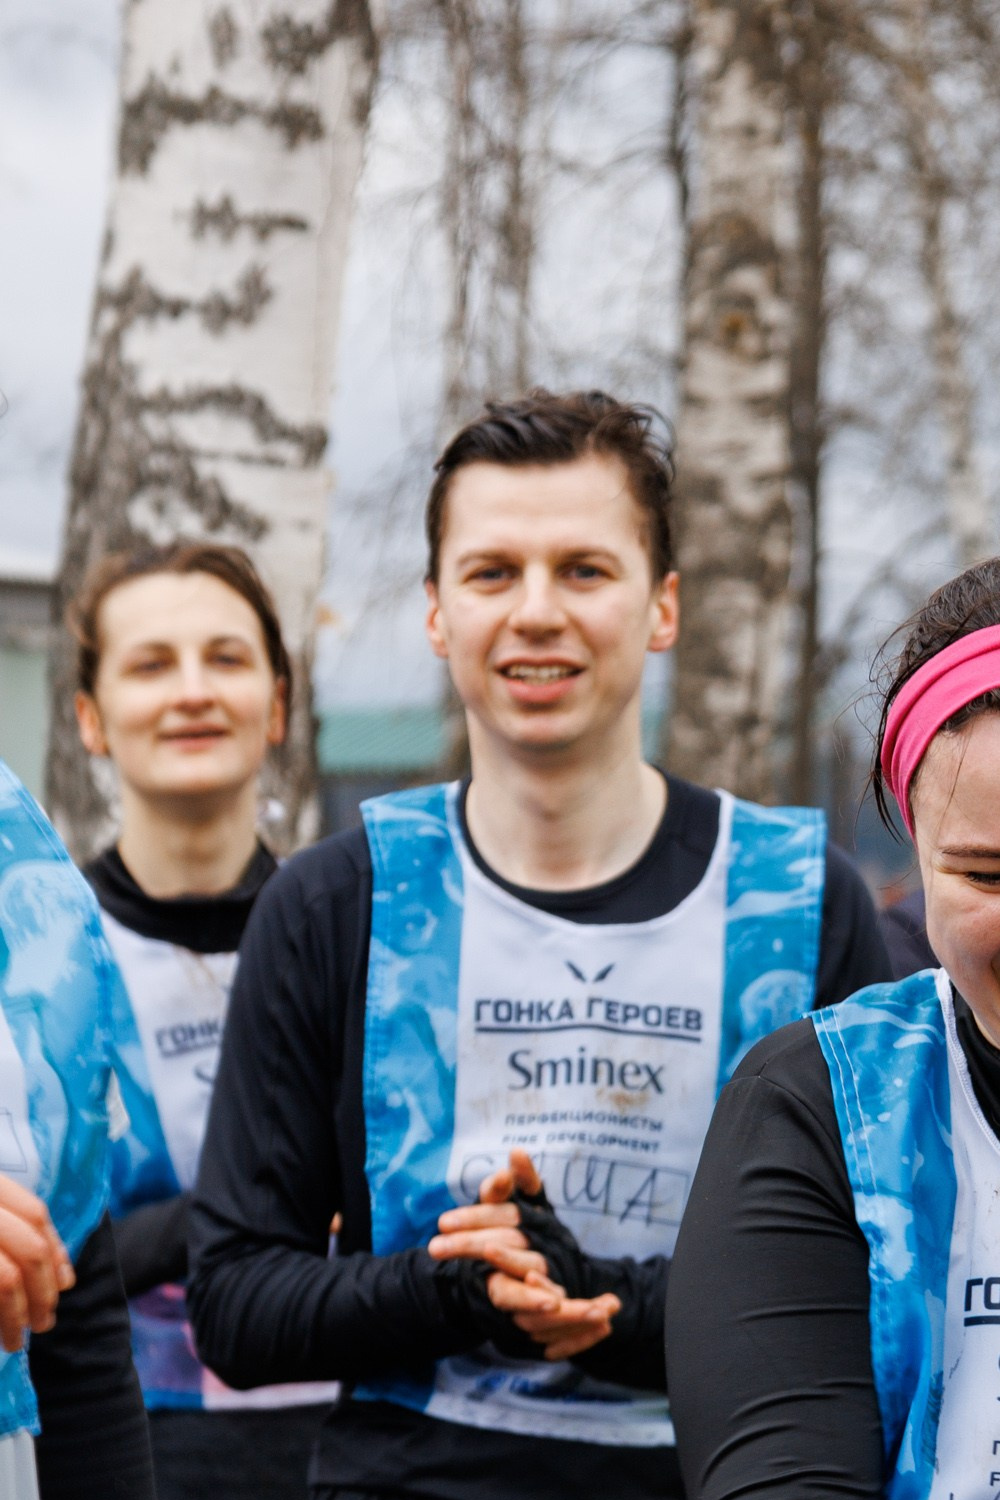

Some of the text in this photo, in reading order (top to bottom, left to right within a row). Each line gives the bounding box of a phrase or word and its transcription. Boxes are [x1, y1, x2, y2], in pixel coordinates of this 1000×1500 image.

[474, 998, 704, 1031] ГОНКА ГЕРОЕВ
[155, 1018, 220, 1048] ГОНК
[507, 1046, 666, 1094] Sminex
[504, 1112, 664, 1133] ПЕРФЕКЦИОНИСТЫ
[502, 1132, 660, 1154] FINE DEVELOPMENT
